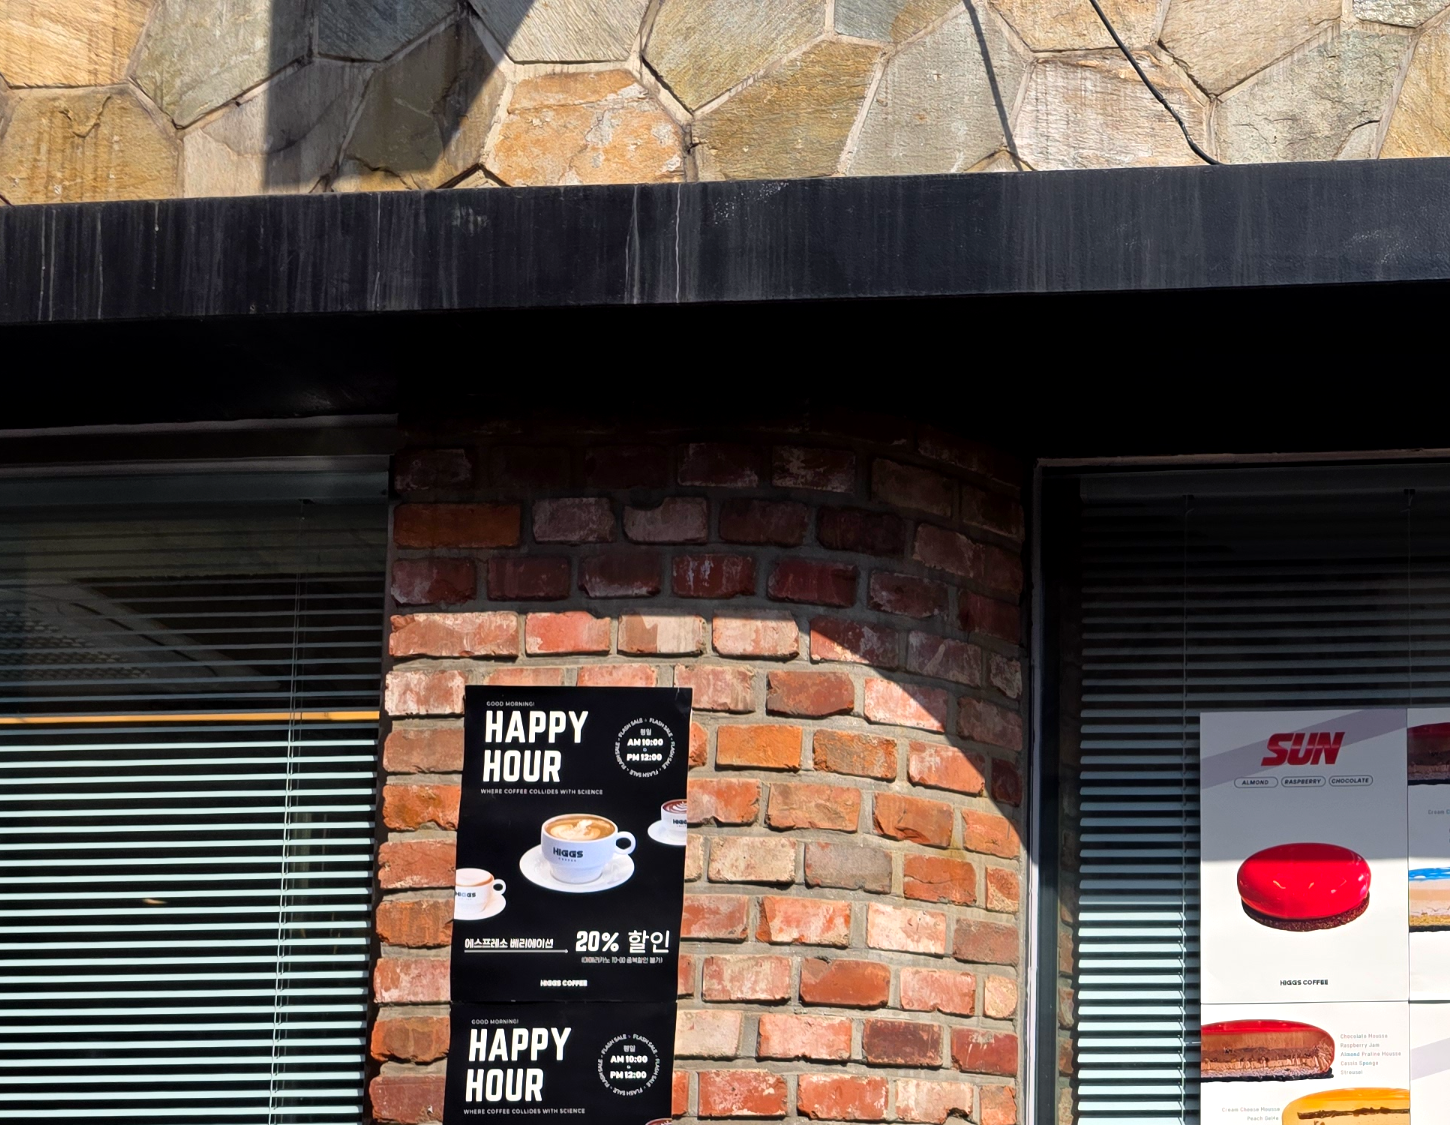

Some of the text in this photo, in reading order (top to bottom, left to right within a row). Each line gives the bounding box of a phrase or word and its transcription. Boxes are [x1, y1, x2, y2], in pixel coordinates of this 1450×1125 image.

[485, 710, 589, 744] HAPPY
[627, 738, 664, 747] AM 10:00
[1260, 731, 1346, 767] SUN
[627, 753, 663, 762] PM 12:00
[483, 749, 562, 783] HOUR
[553, 846, 583, 858] HIGGS
[464, 938, 553, 949] 에스프레소 베리에이션
[575, 930, 670, 954] 20% 할인
[540, 979, 588, 987] HIGGS COFFEE
[469, 1027, 572, 1062] HAPPY
[610, 1055, 648, 1063] AM 10:00
[610, 1071, 647, 1079] PM 12:00
[466, 1068, 544, 1102] HOUR
